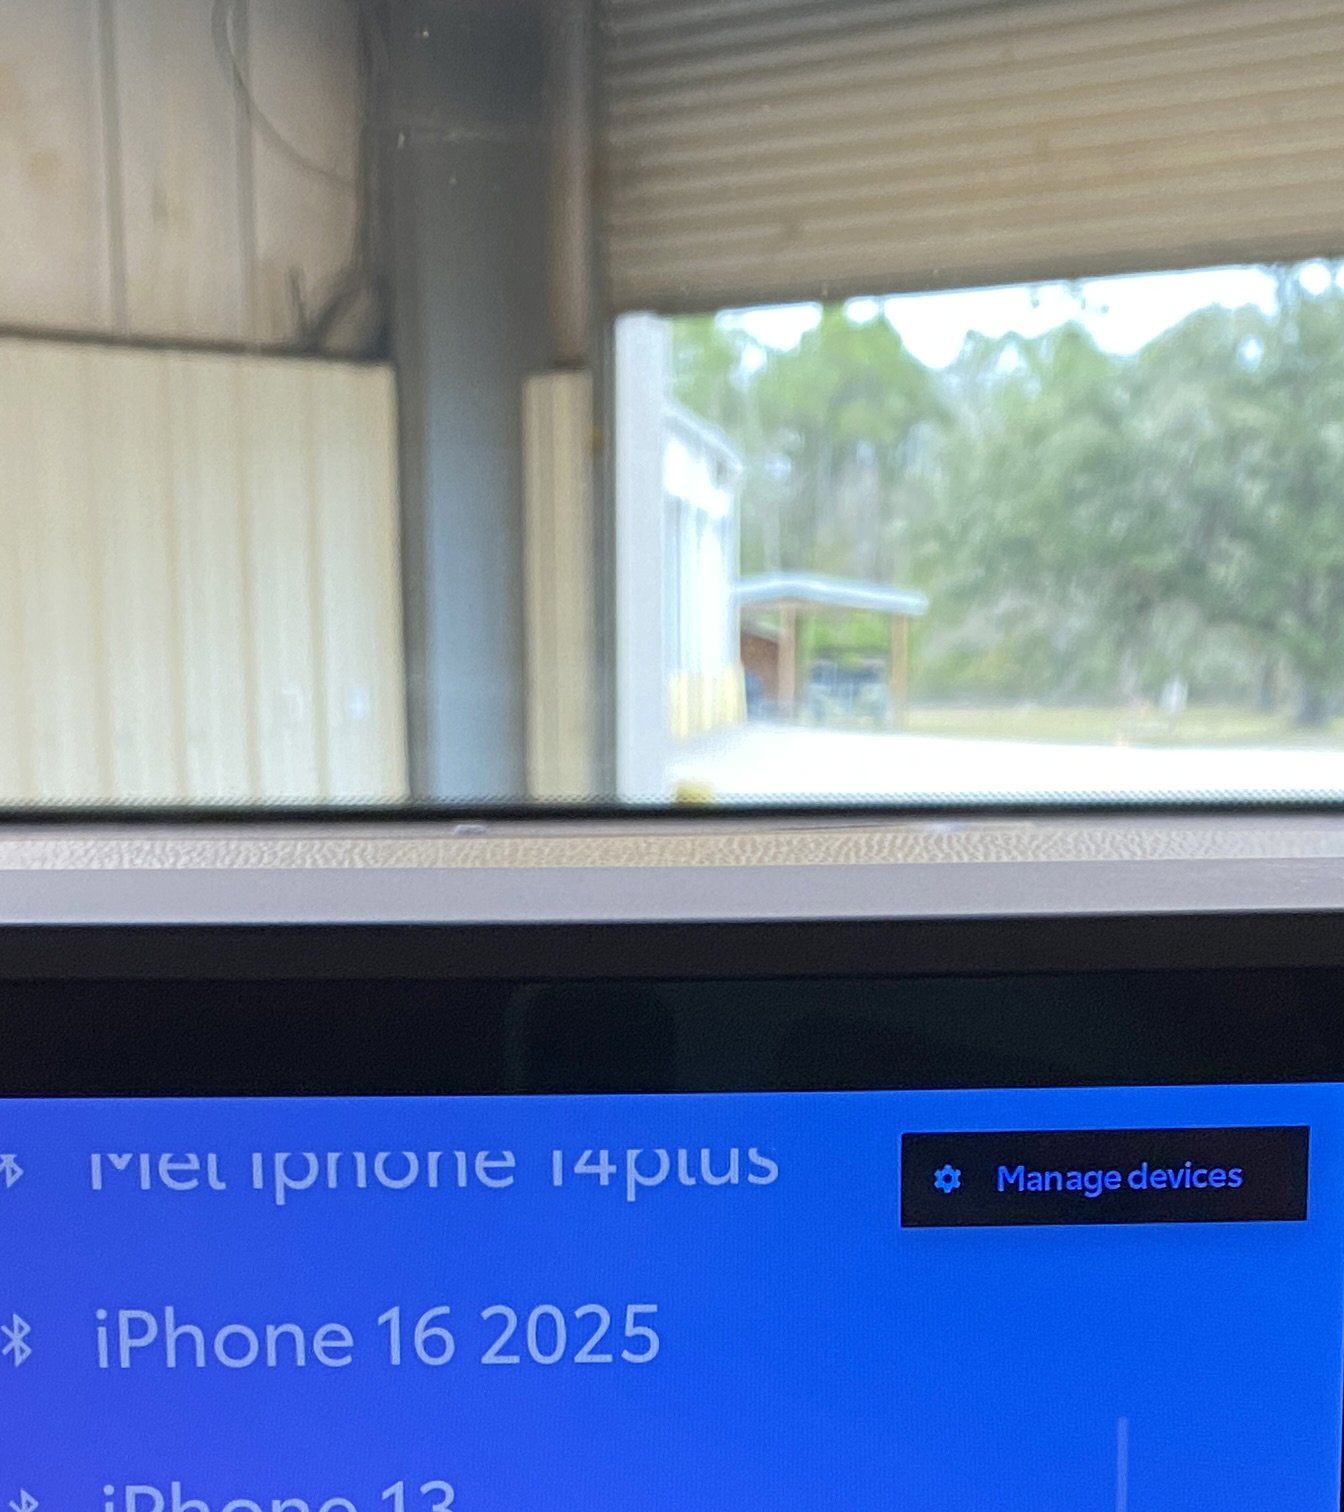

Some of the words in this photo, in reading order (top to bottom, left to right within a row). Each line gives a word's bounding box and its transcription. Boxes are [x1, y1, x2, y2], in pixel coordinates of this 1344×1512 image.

[551, 1147, 779, 1202] 14plus
[996, 1164, 1121, 1198] Manage
[1127, 1160, 1244, 1191] devices
[95, 1305, 355, 1369] iPhone
[377, 1305, 457, 1367] 16
[479, 1302, 661, 1365] 2025
